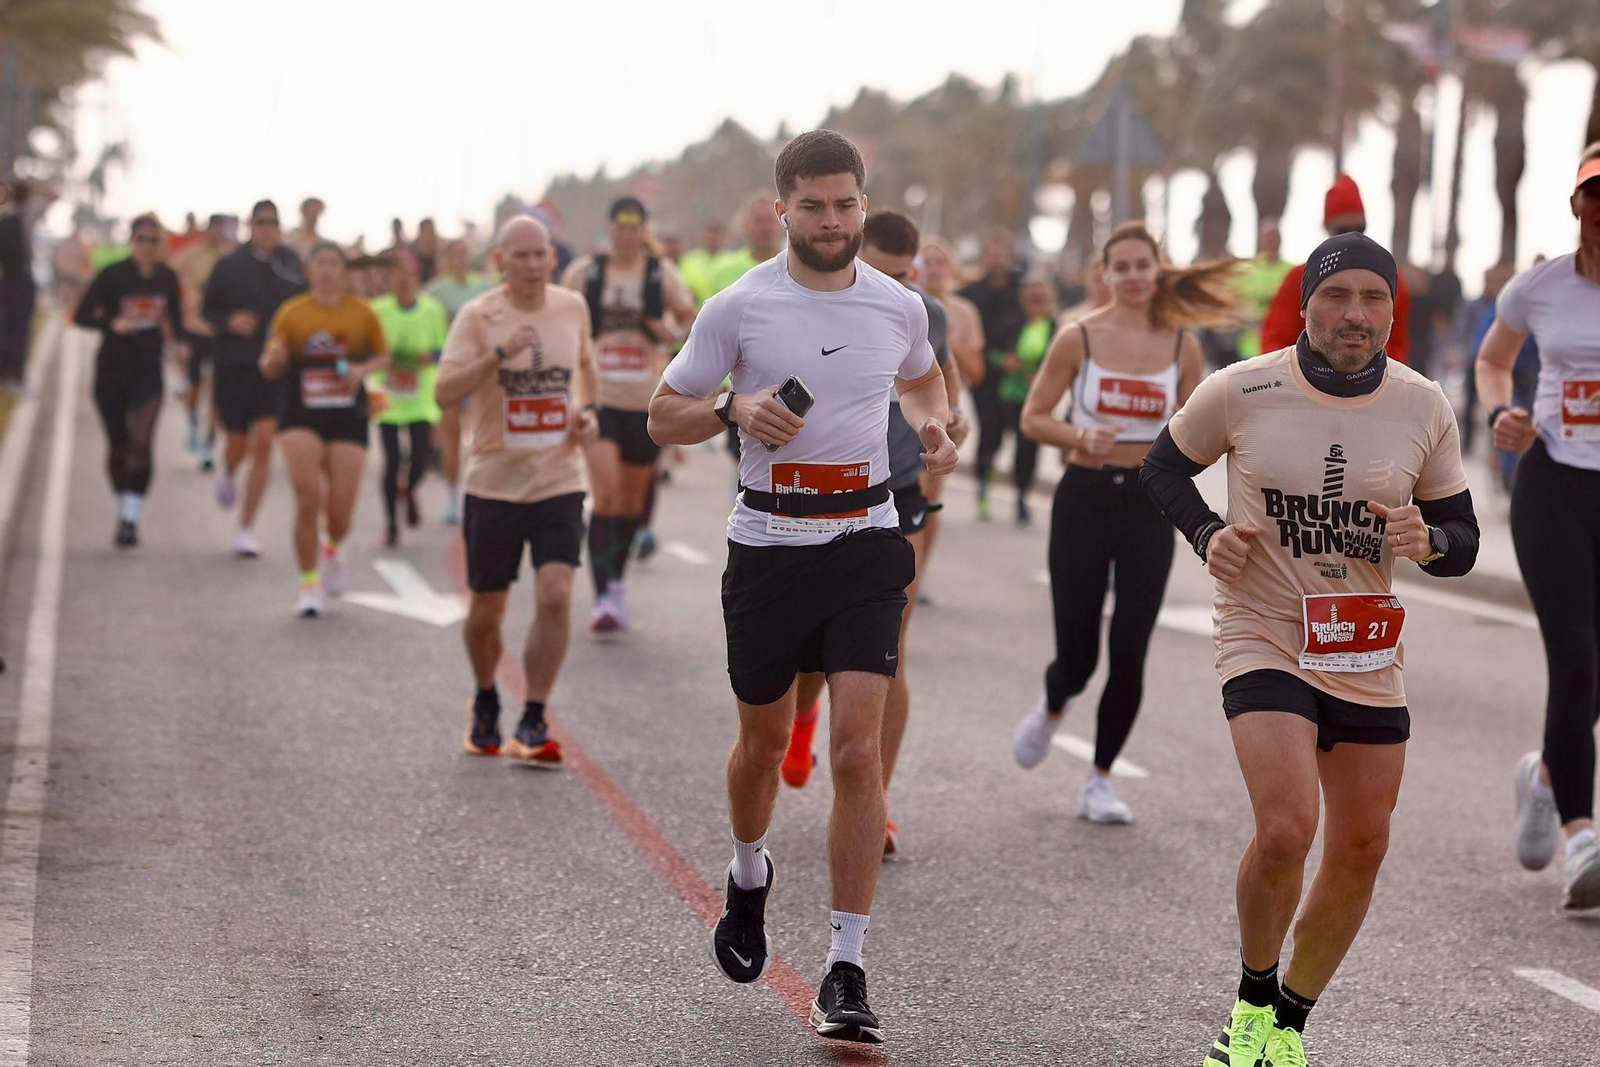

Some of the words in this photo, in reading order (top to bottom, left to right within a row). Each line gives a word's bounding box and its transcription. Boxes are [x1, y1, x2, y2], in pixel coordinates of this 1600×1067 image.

[1346, 366, 1376, 380] GARMIN
[1242, 381, 1271, 394] luanvi
[1261, 487, 1387, 535] BRUNCH
[1276, 518, 1344, 558] RUN
[1344, 541, 1382, 564] 2025
[1311, 621, 1356, 634] BRUNCH
[1367, 621, 1388, 640] 21
[1316, 631, 1338, 645] RUN
